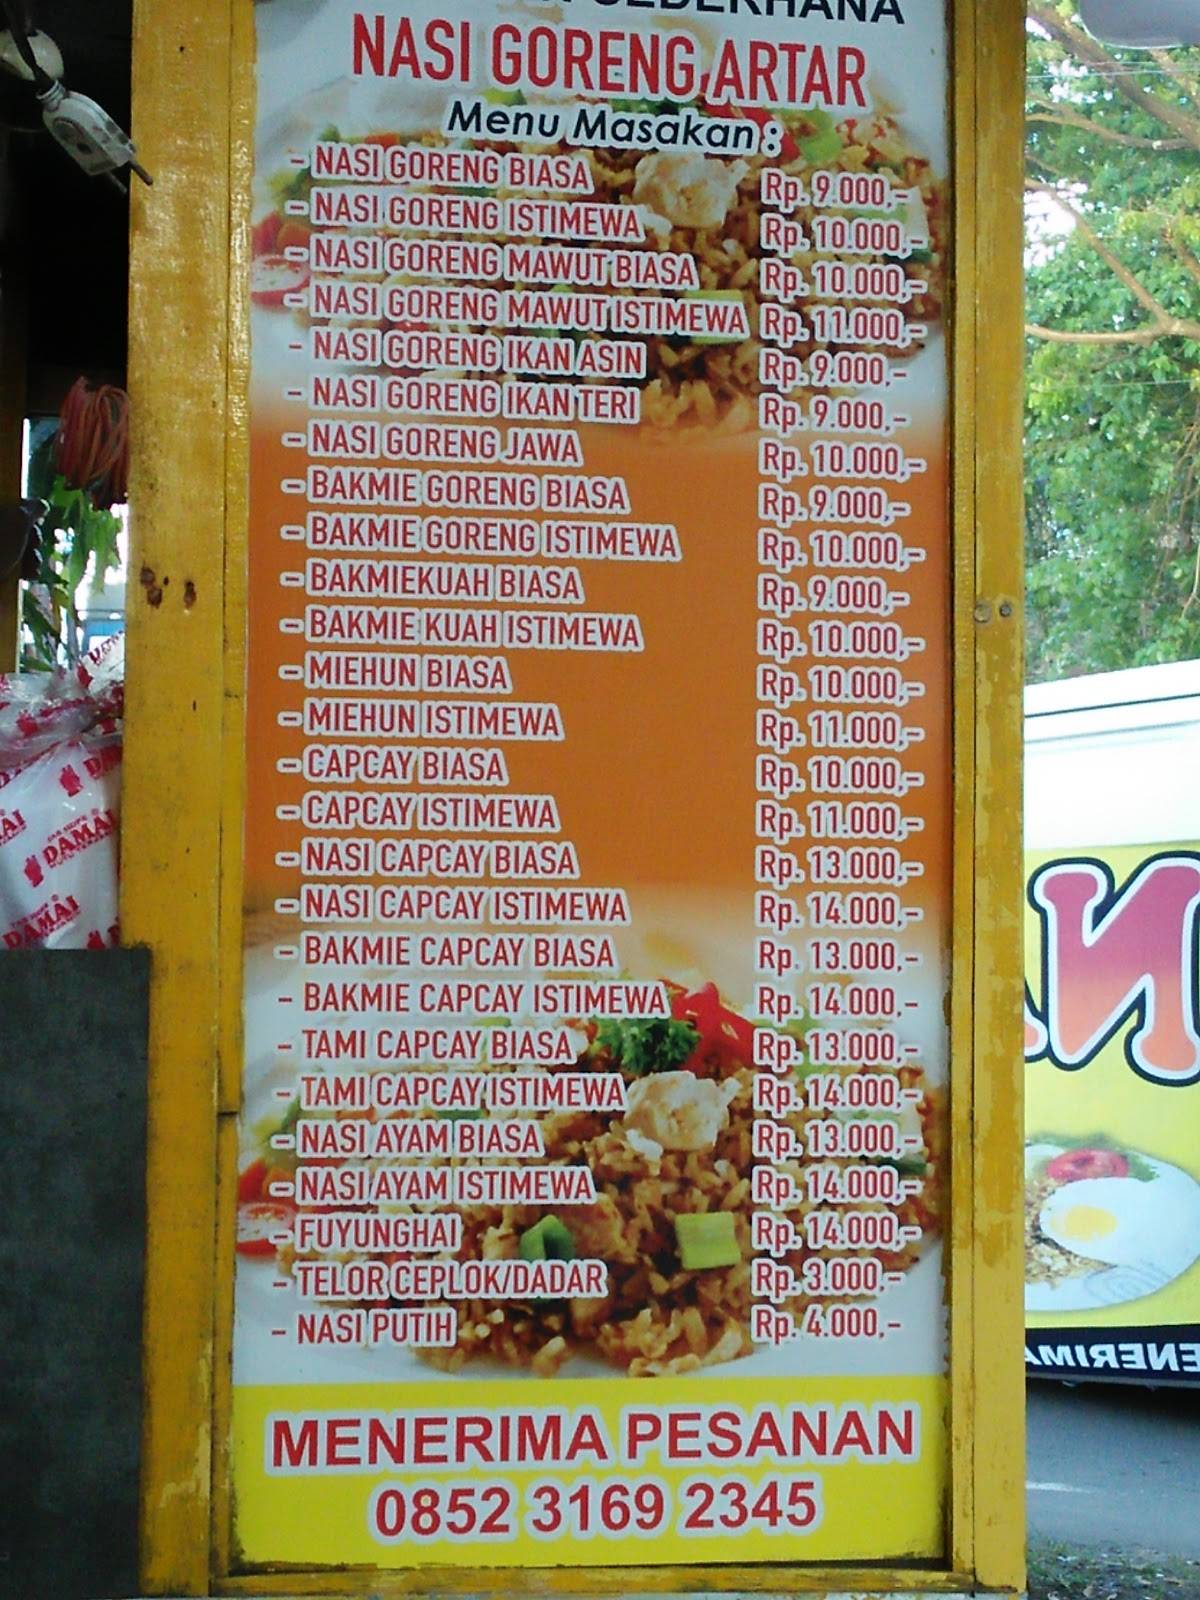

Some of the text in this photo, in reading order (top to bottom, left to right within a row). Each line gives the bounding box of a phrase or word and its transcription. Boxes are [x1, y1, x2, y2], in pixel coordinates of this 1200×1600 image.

[353, 14, 866, 107] NASI GORENG ARTAR
[448, 101, 560, 137] Menu
[572, 109, 753, 149] Masakan
[315, 147, 907, 207] NASI GORENG BIASA Rp. 9.000,-
[315, 194, 923, 253] NASI GORENG ISTIMEWA Rp. 10.000,-
[315, 240, 922, 298] NASI GORENG MAWUT BIASA Rp. 10.000,-
[314, 287, 922, 342] NASI GORENG MAWUT ISTIMEWA Rp. 11.000,-
[313, 332, 906, 386] NASI GORENG IKAN ASIN Rp. 9.000,-
[313, 379, 906, 431] NASI GORENG IKAN TERI Rp. 9.000,-
[312, 426, 921, 477] NASI GORENG JAWA Rp. 10.000,-
[312, 470, 905, 521] BAKMIE GORENG BIASA Rp. 9.000,-
[311, 517, 921, 566] BAKMIE GORENG ISTIMEWA Rp. 10.000,-
[500, 570, 579, 599] BIASA
[763, 577, 802, 611] Rp.
[813, 580, 904, 611] 9.000,-
[310, 610, 920, 657] BAKMIE KUAH ISTIMEWA Rp. 10.000,-
[309, 656, 920, 703] MIEHUN BIASA Rp. 10.000,-
[308, 703, 920, 747] MIEHUN ISTIMEWA Rp. 11.000,-
[307, 749, 919, 793] CAPCAY BIASA Rp. 10.000,-
[43, 810, 117, 866] DAMAI
[306, 796, 919, 839] CAPCAY ISTIMEWA Rp. 11.000,-
[306, 843, 919, 883] NASI CAPCAY BIASA Rp. 13.000,-
[305, 889, 919, 929] NASI CAPCAY ISTIMEWA Rp. 14.000,-
[305, 936, 918, 974] BAKMIE CAPCAY BIASA Rp. 13.000,-
[304, 983, 918, 1020] BAKMIE CAPCAY ISTIMEWA Rp. 14.000,-
[302, 1029, 918, 1065] TAMI CAPCAY BIASA Rp. 13.000,-
[302, 1077, 917, 1112] TAMI CAPCAY ISTIMEWA Rp. 14.000,-
[301, 1124, 917, 1157] NASI AYAM BIASA Rp. 13.000,-
[301, 1171, 917, 1204] NASI AYAM ISTIMEWA Rp. 14.000,-
[300, 1217, 917, 1251] FUYUNGHAI Rp. 14.000,-
[299, 1263, 900, 1296] TELOR CEPLOK/DADAR Rp. 3.000,-
[298, 1309, 900, 1343] NASI PUTIH Rp. 4.000,-
[273, 1411, 914, 1467] MENERIMA PESANAN
[376, 1480, 816, 1537] 0852 3169 2345
